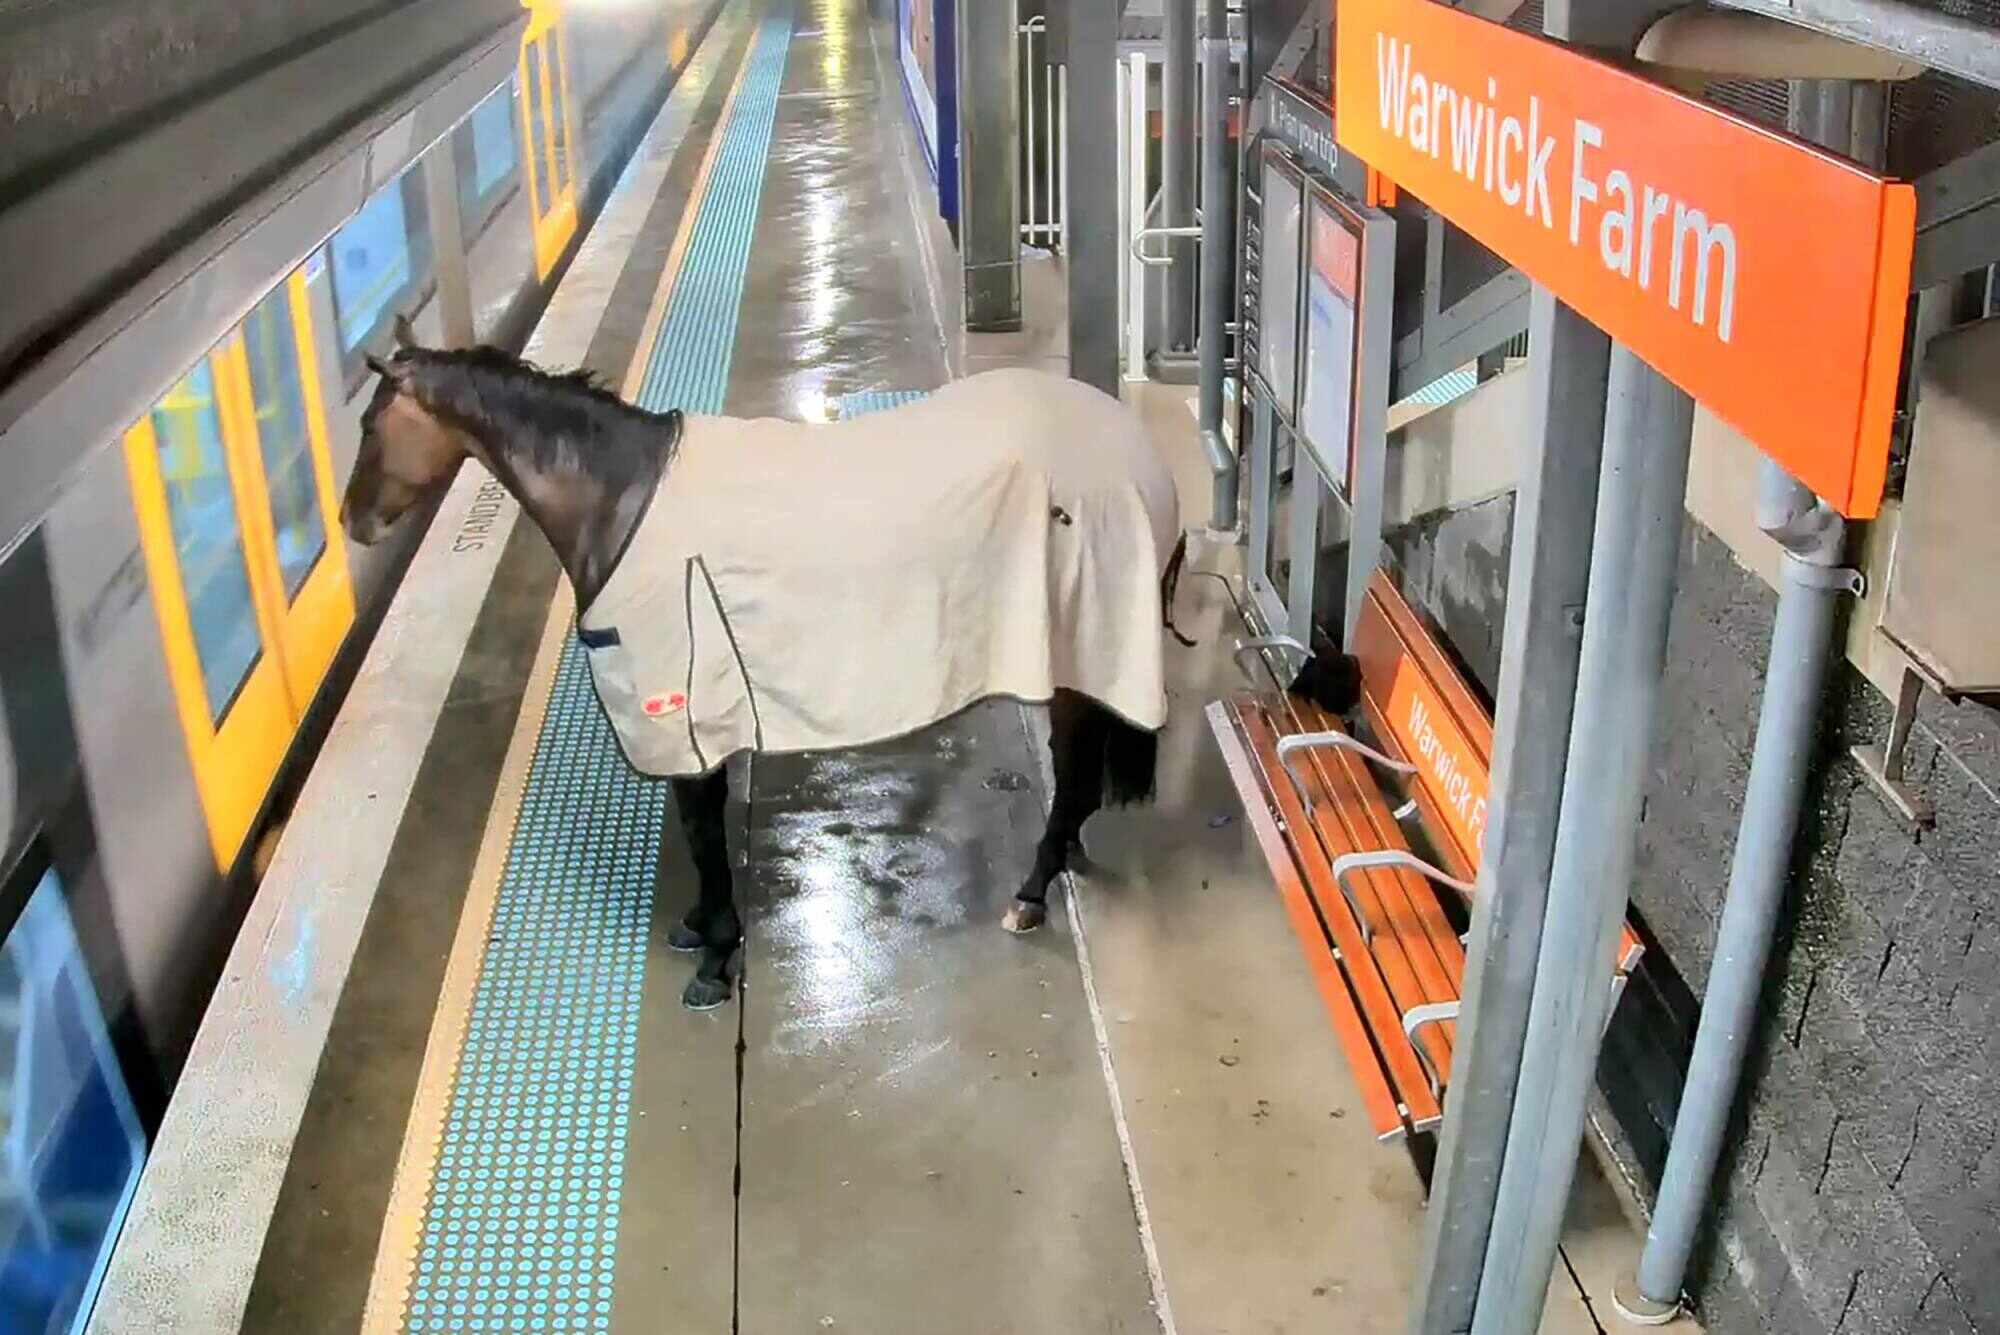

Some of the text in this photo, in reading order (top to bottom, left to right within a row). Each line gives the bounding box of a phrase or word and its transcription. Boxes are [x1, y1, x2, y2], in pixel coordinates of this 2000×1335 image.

[1377, 31, 1736, 343] Warwick Farm
[452, 502, 500, 552] STAND
[1408, 693, 1473, 821] Warwick
